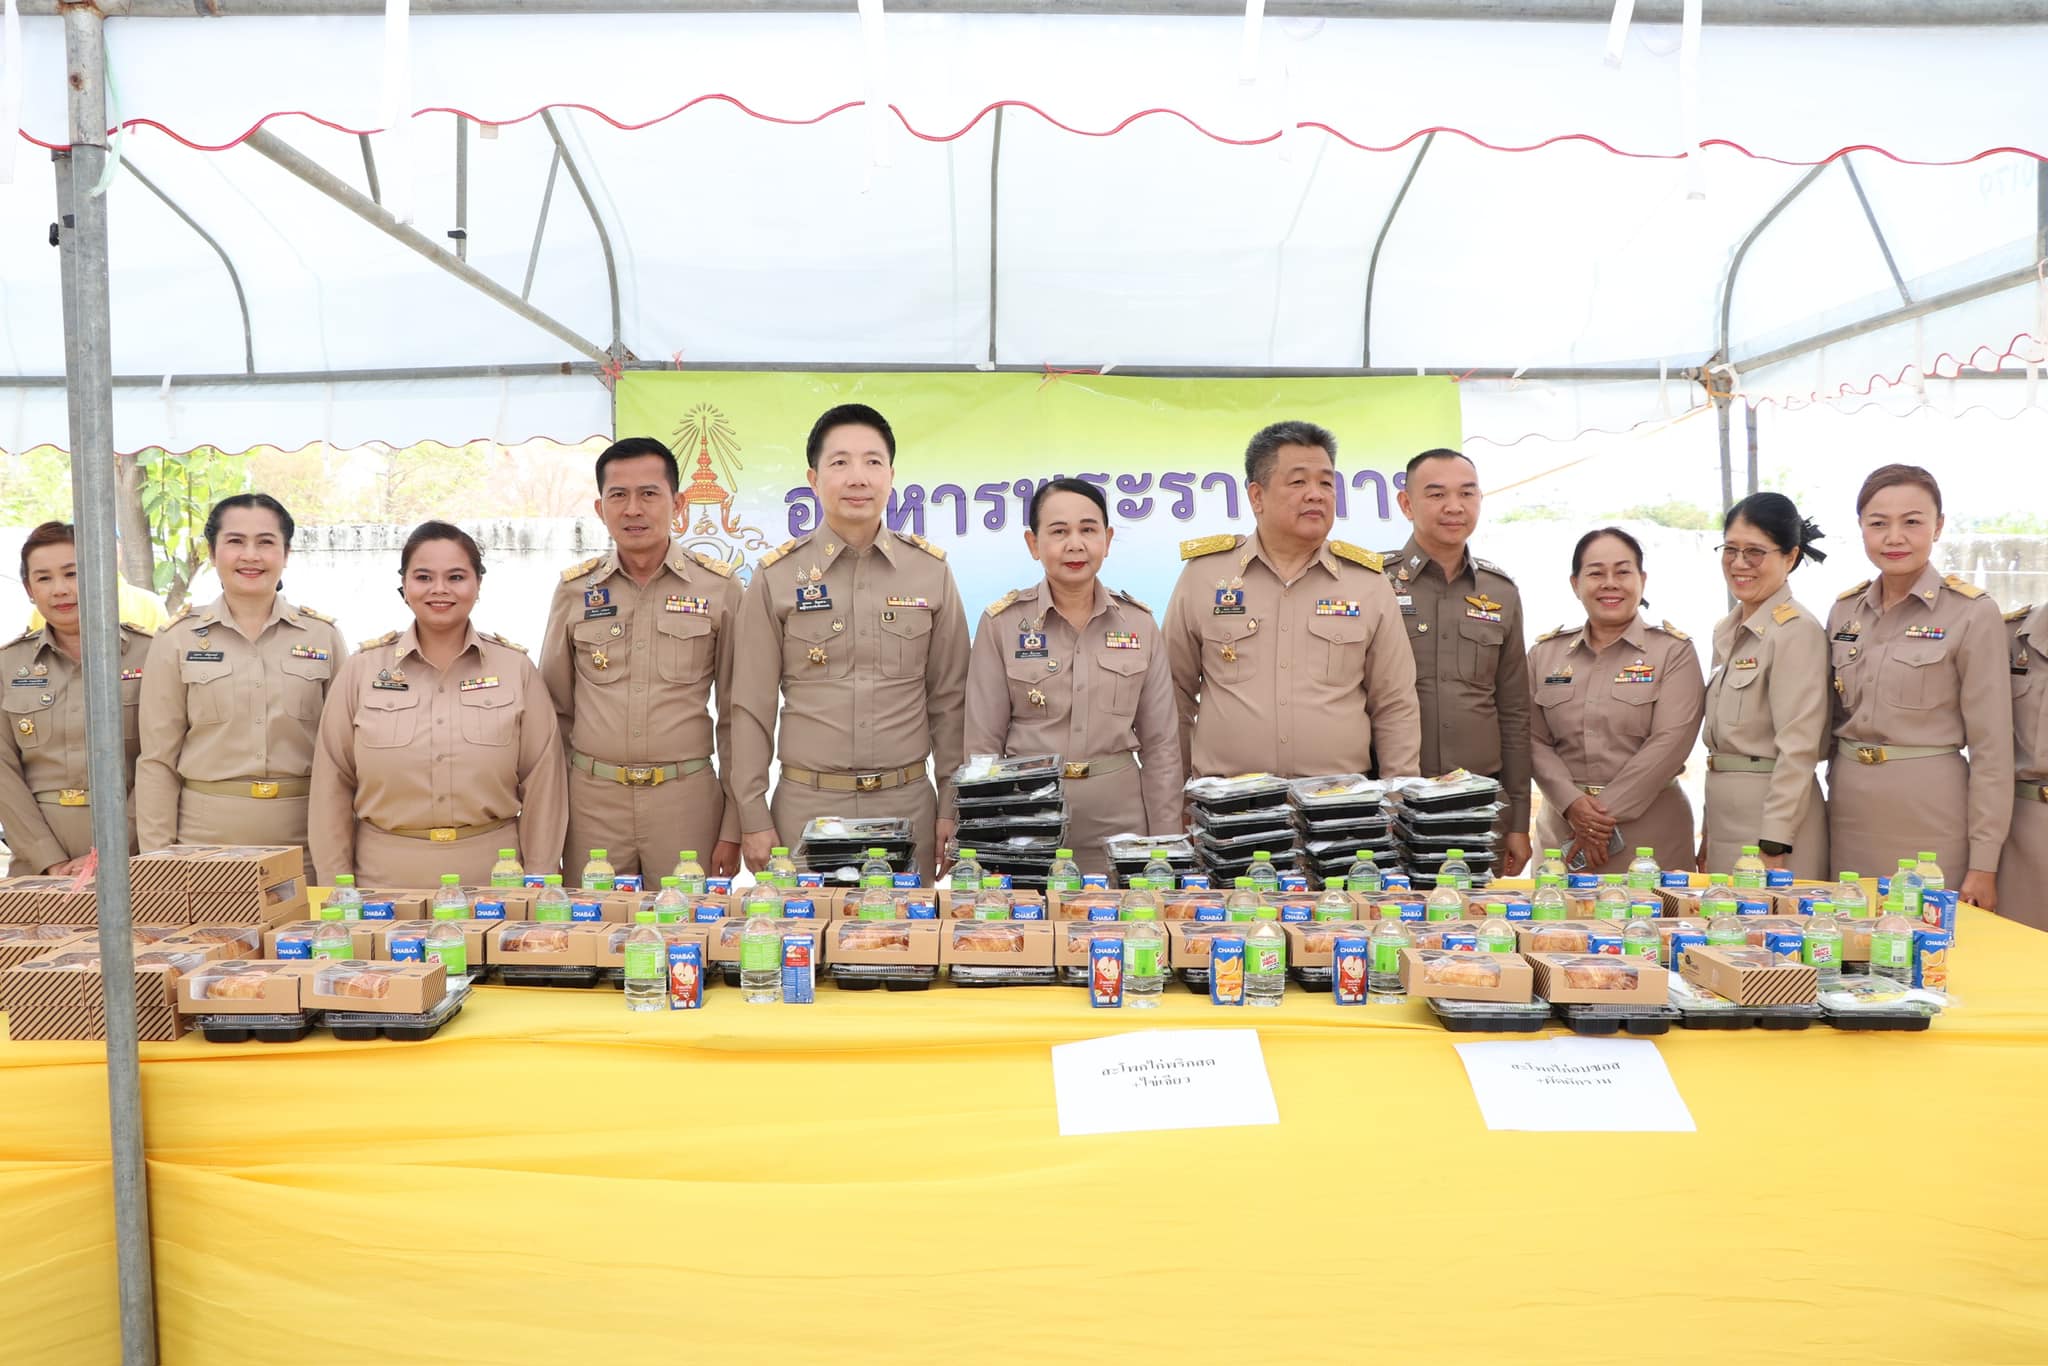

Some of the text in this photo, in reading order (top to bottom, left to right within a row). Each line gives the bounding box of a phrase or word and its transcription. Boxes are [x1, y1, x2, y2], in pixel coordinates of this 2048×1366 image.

[1284, 912, 1308, 920] CHABAA
[1094, 946, 1120, 954] CHABAA
[670, 951, 696, 960] CHABAA
